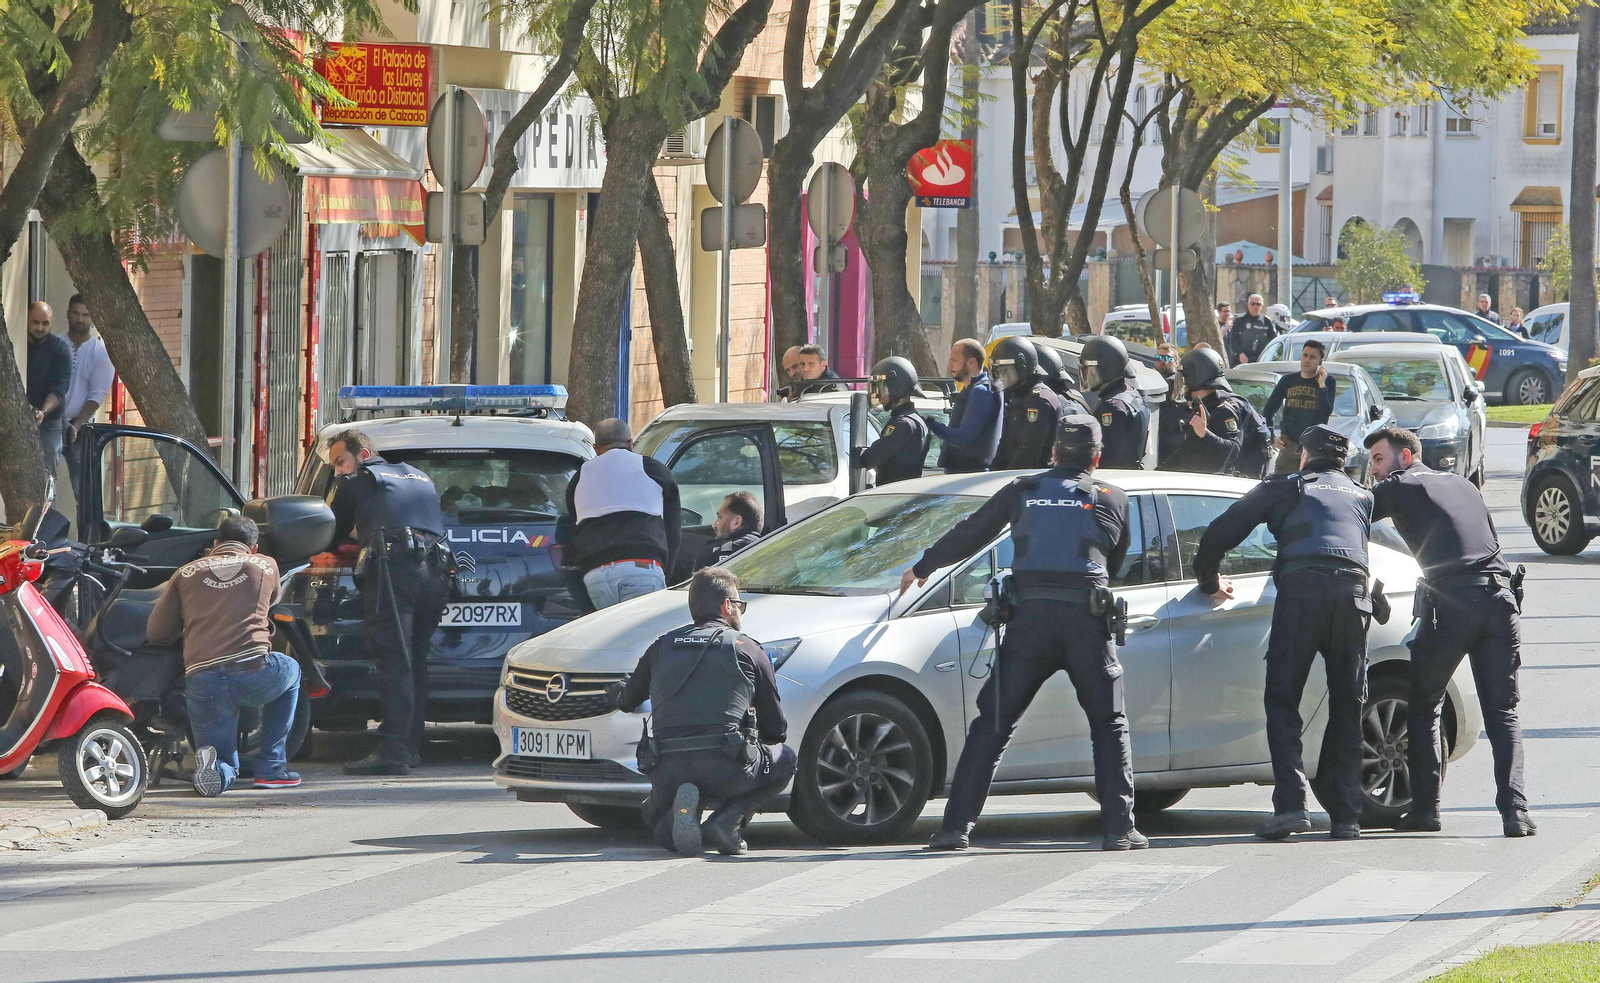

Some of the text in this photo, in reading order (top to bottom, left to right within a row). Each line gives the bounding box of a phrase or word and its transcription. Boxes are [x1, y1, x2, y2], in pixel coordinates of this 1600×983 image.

[373, 48, 426, 69] El Palacio de
[383, 68, 395, 86] las
[348, 85, 378, 105] Mando
[380, 91, 386, 105] a
[387, 87, 425, 106] Distancia
[324, 107, 425, 122] Reparación de Calzado
[933, 197, 966, 206] TELEBANCO
[1025, 499, 1084, 508] POLICIA
[447, 527, 530, 544] LICÍA
[202, 572, 249, 589] SELECTION
[520, 731, 585, 756] 3091 KPM
